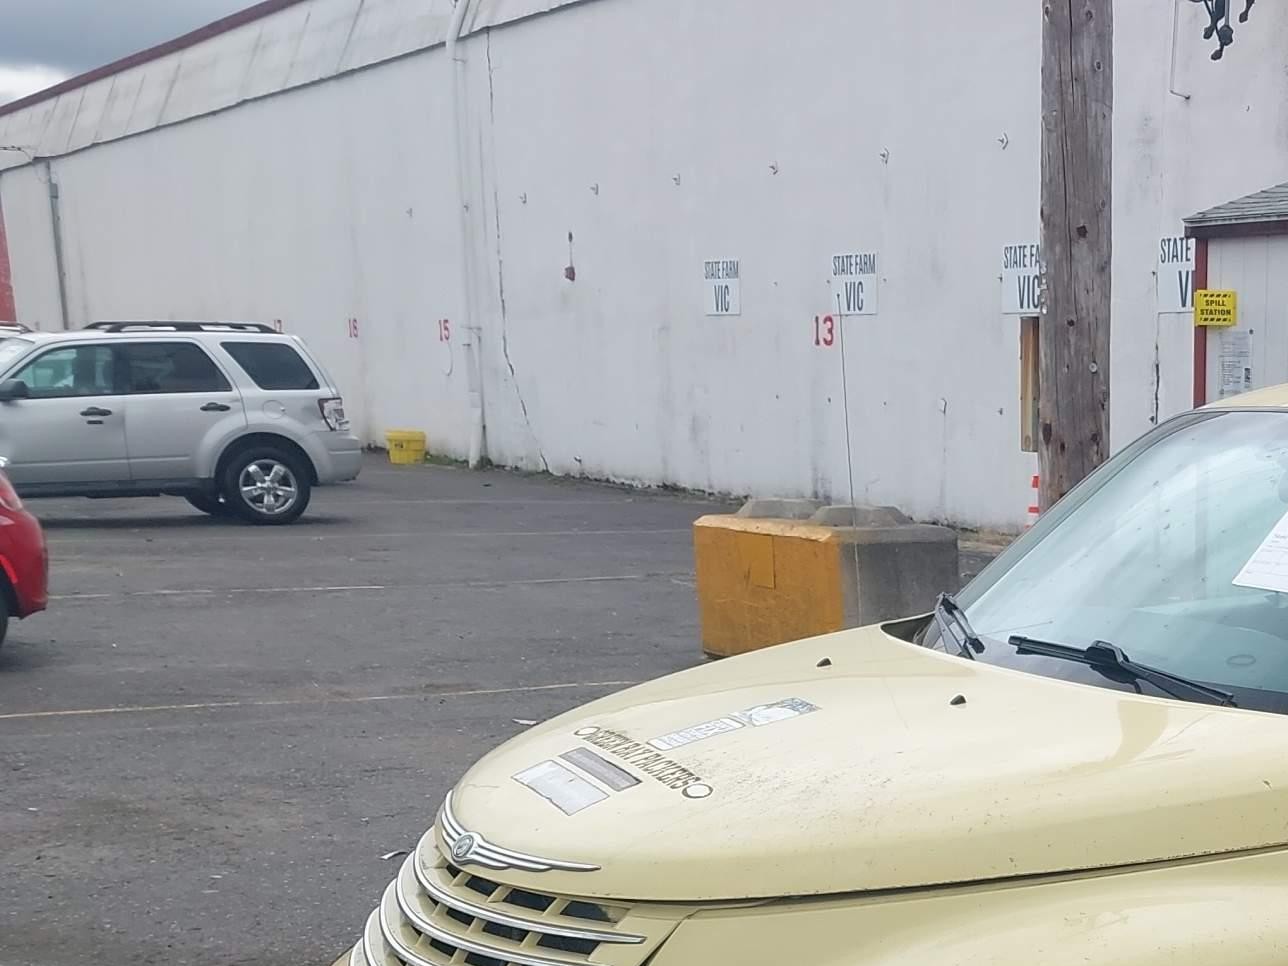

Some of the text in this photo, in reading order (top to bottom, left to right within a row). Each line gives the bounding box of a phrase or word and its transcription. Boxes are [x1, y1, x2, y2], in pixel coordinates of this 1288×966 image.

[1003, 246, 1027, 269] STATE
[1160, 237, 1191, 264] STATE
[705, 261, 739, 279] STATE FARM
[833, 254, 876, 276] STATE FARM
[714, 285, 730, 312] VIC
[845, 281, 864, 312] VIC
[1017, 274, 1040, 309] VIC
[1200, 308, 1231, 316] STATION
[438, 319, 450, 342] 15
[815, 315, 835, 346] 13
[630, 753, 702, 790] PACKERS
